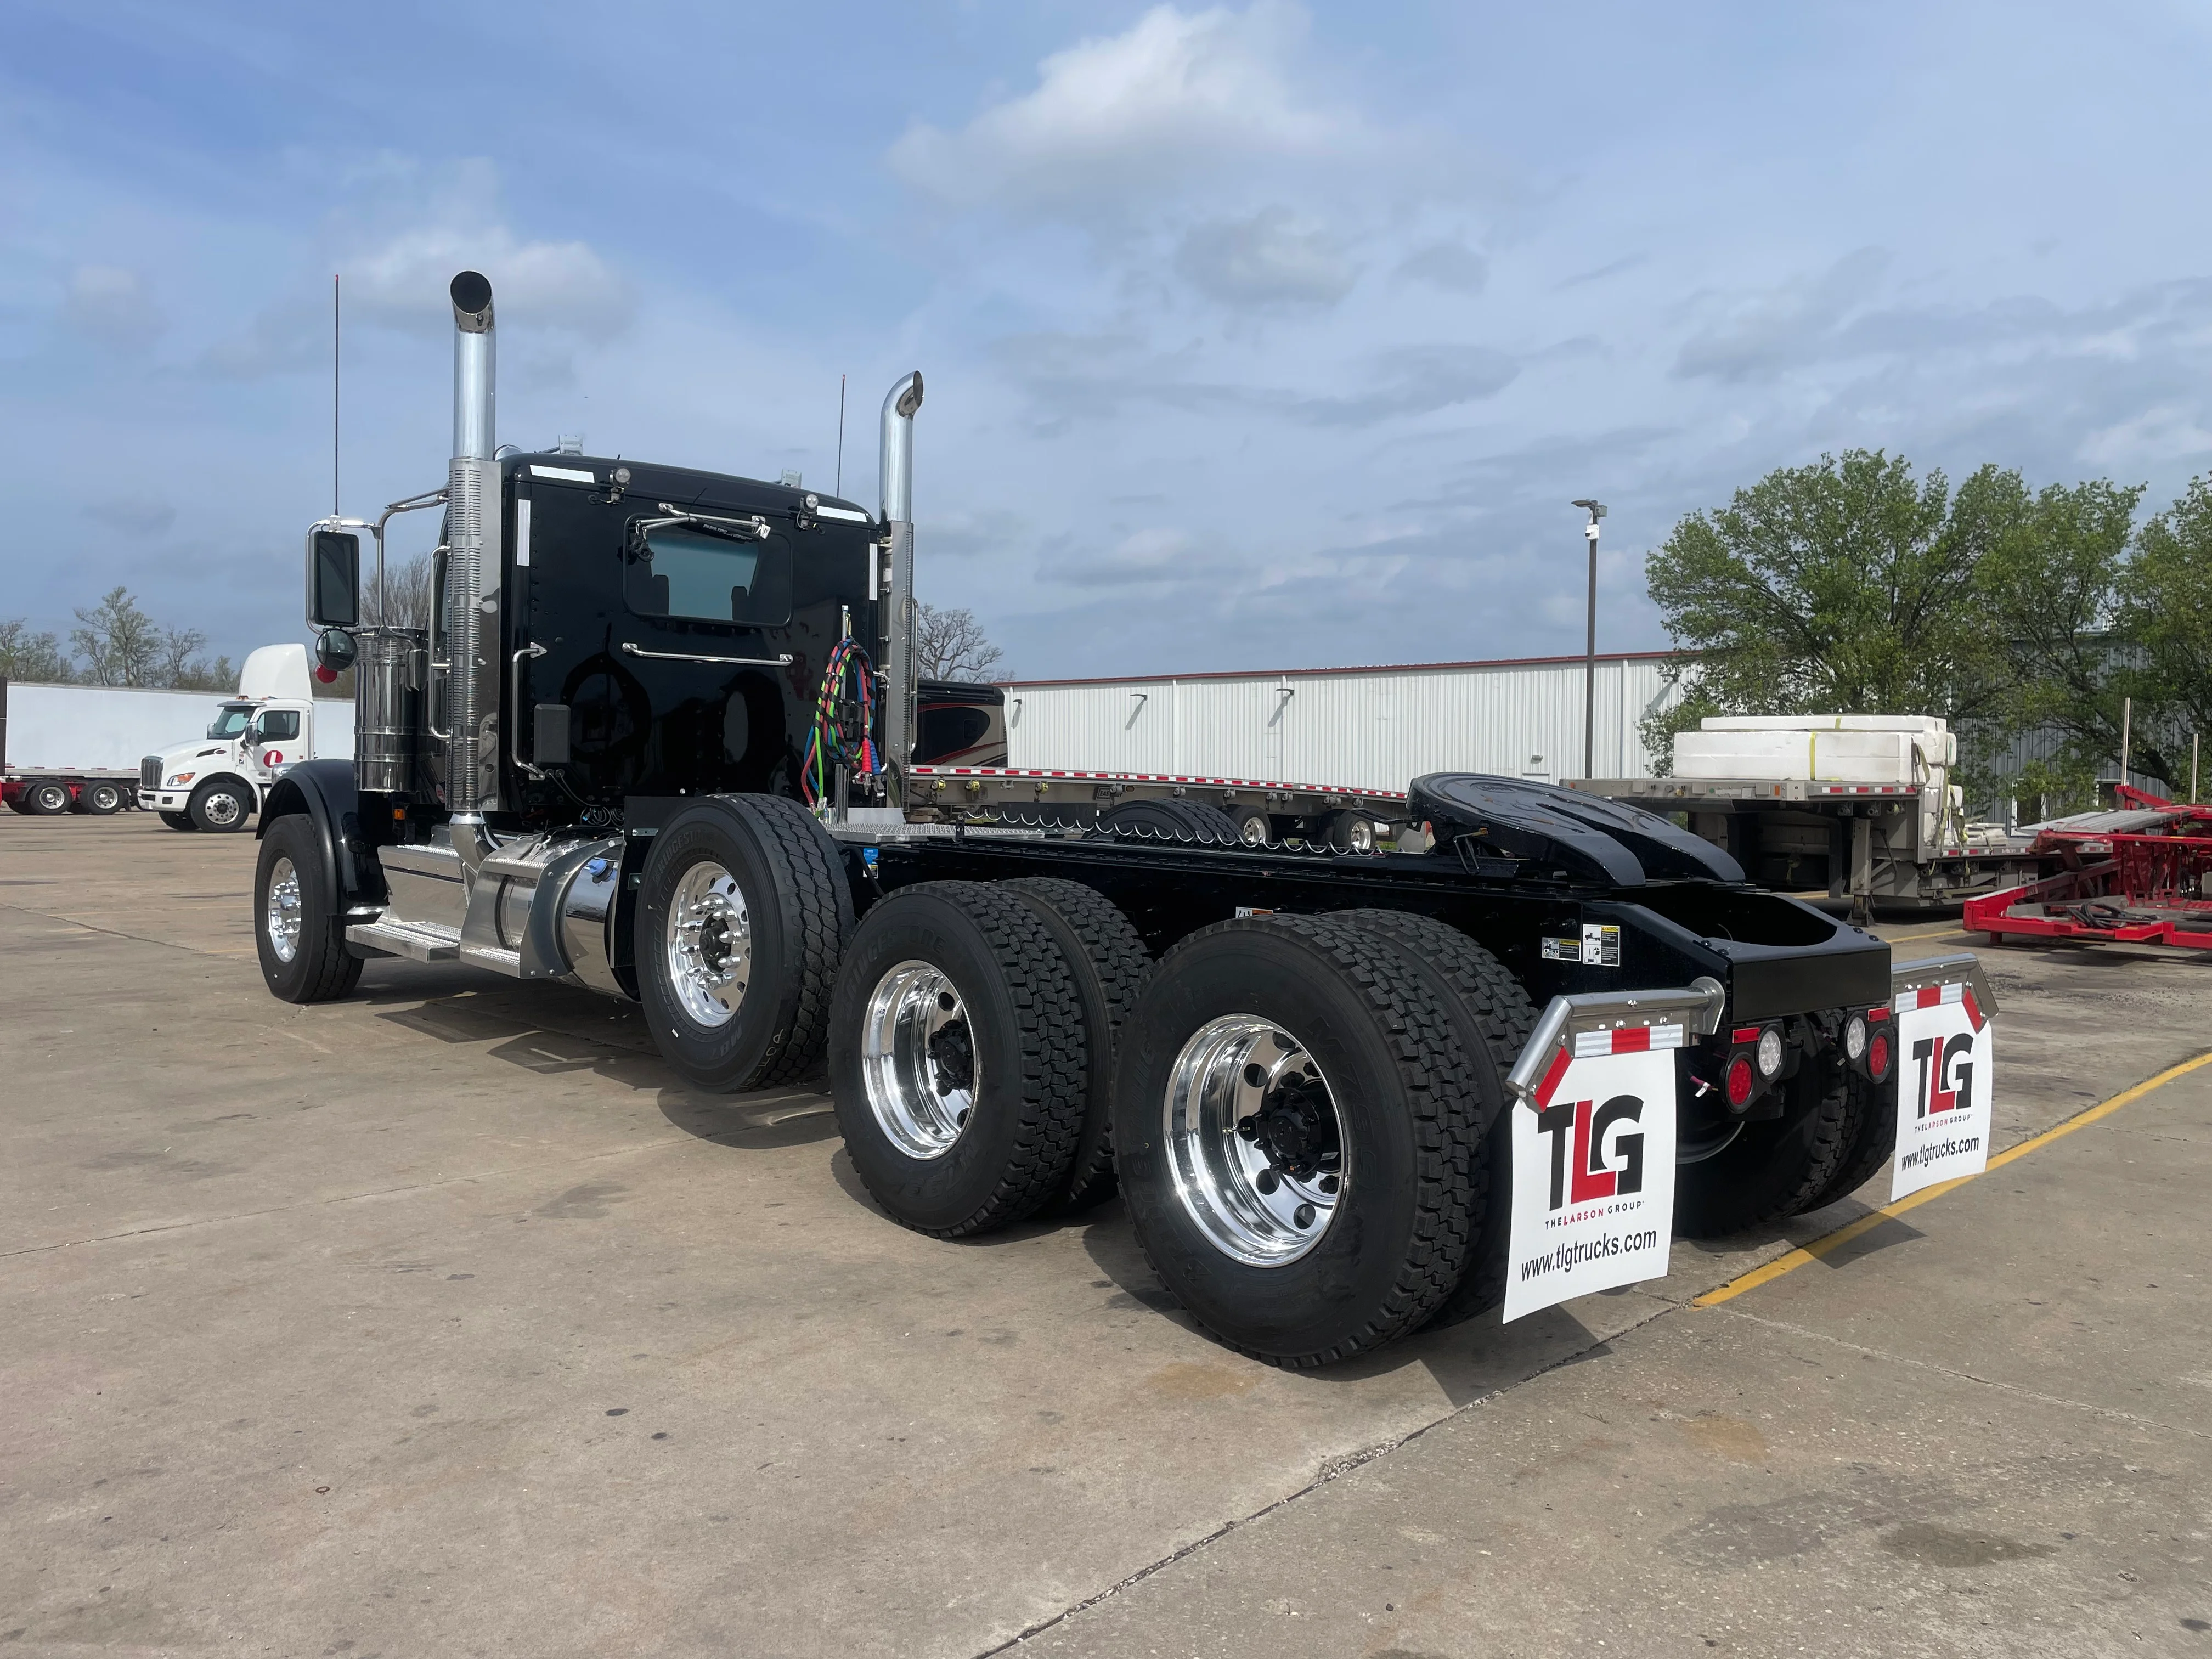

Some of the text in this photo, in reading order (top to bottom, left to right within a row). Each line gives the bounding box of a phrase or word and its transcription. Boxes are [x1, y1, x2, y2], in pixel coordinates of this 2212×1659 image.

[1912, 1032, 1974, 1120] TLG
[1949, 1114, 1971, 1124] GROUP
[1537, 1094, 1644, 1211] TLG
[1901, 1136, 1979, 1171] www.tlgtrucks.com
[1607, 1200, 1642, 1214] GROUP
[1521, 1229, 1656, 1281] www.tlgtrucks.com
